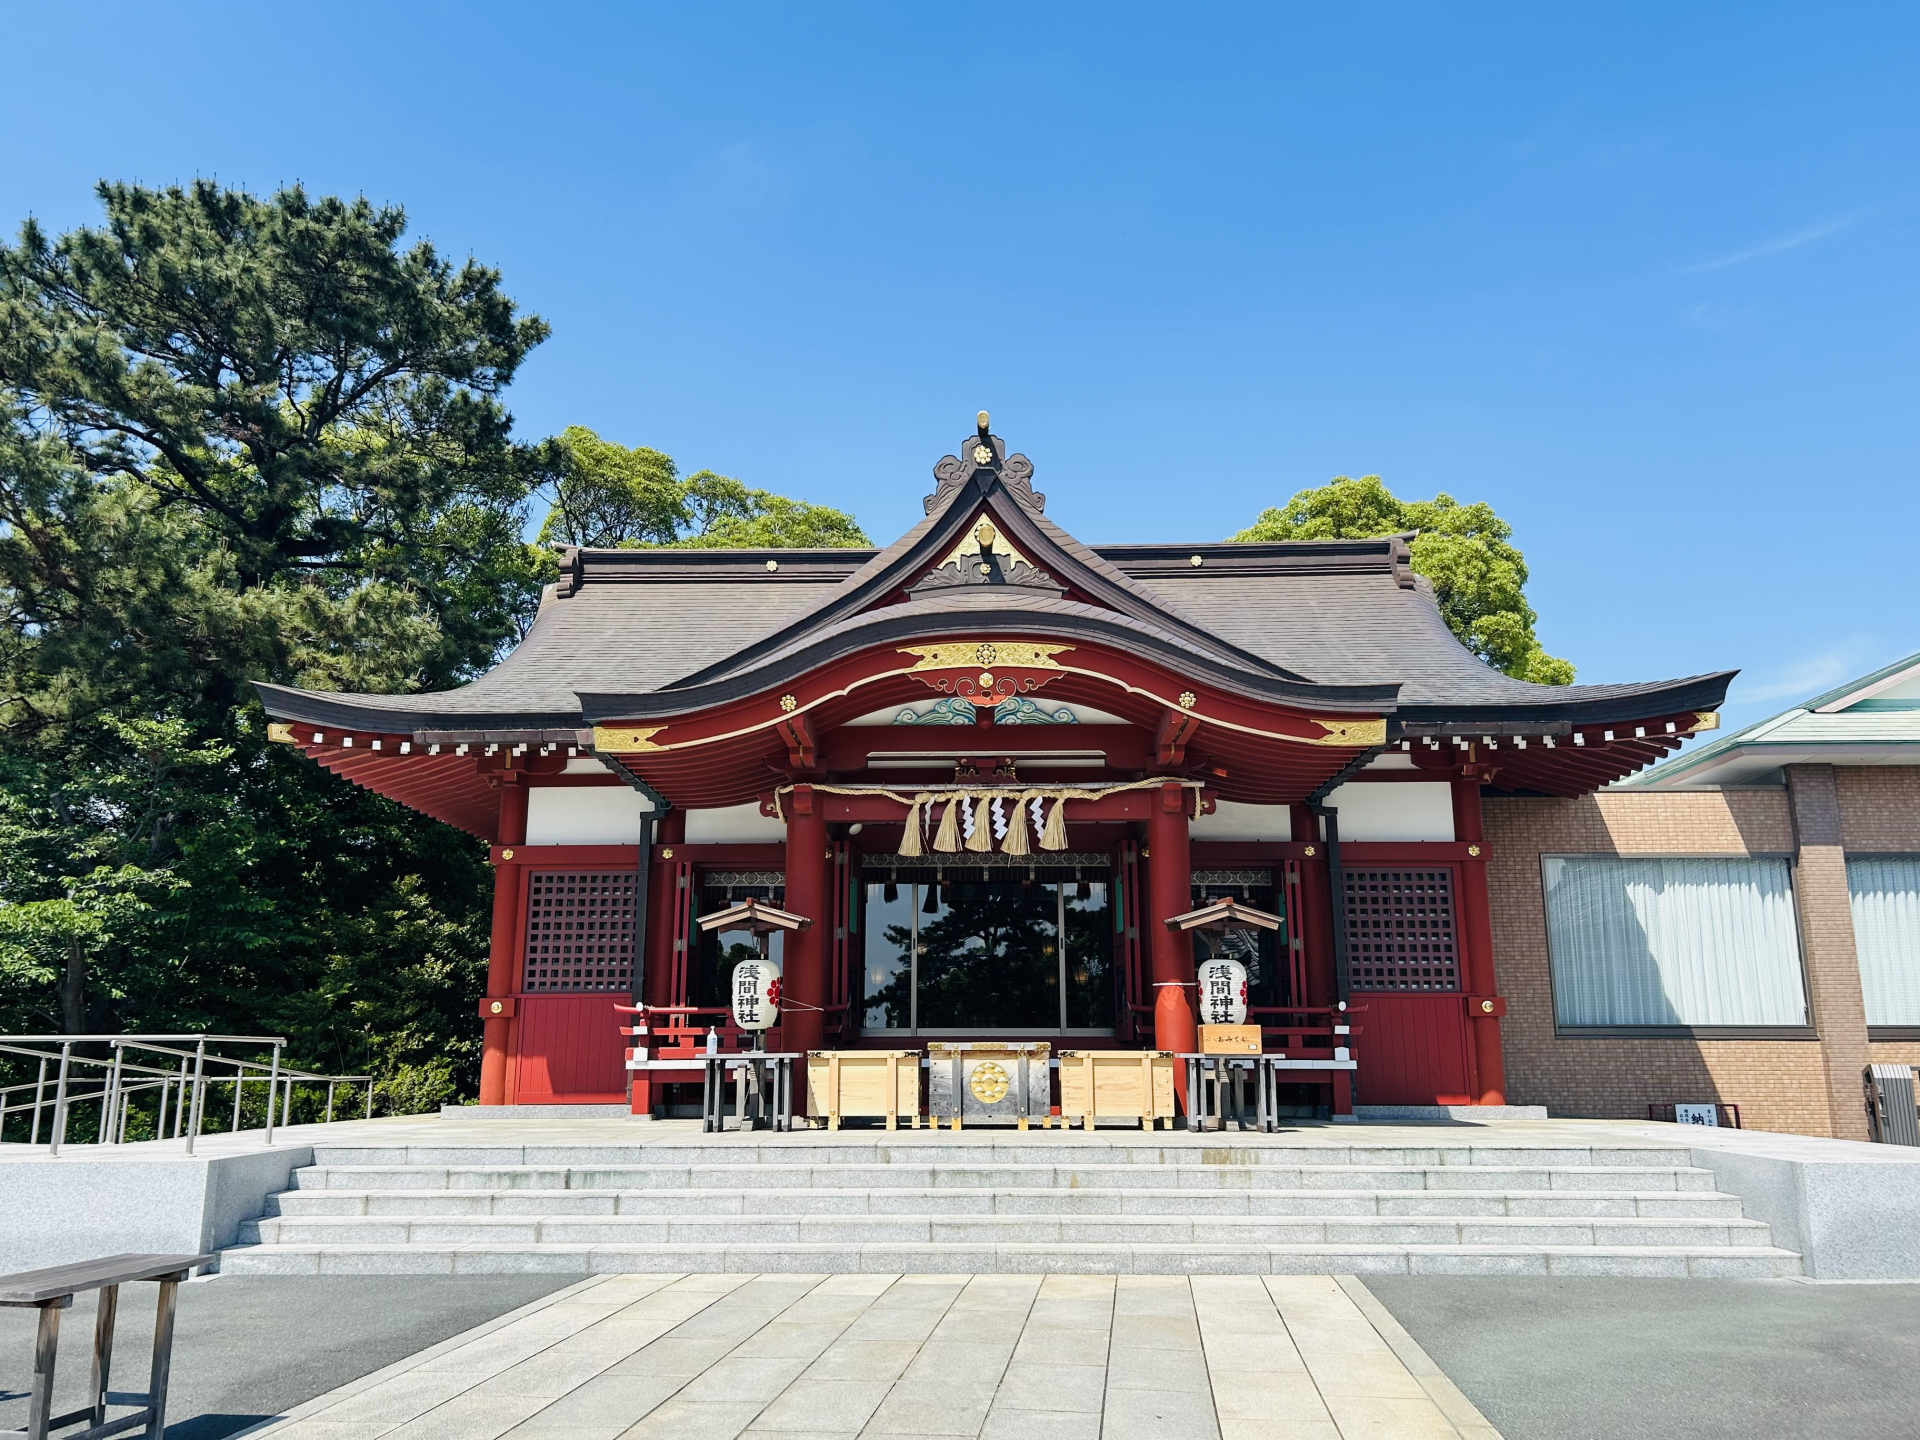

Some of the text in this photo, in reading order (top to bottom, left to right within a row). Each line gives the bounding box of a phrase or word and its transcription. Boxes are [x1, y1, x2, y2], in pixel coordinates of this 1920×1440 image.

[738, 965, 761, 1023] 浅間神社
[1209, 965, 1235, 1024] 浅間神社
[1691, 1112, 1705, 1125] 納
